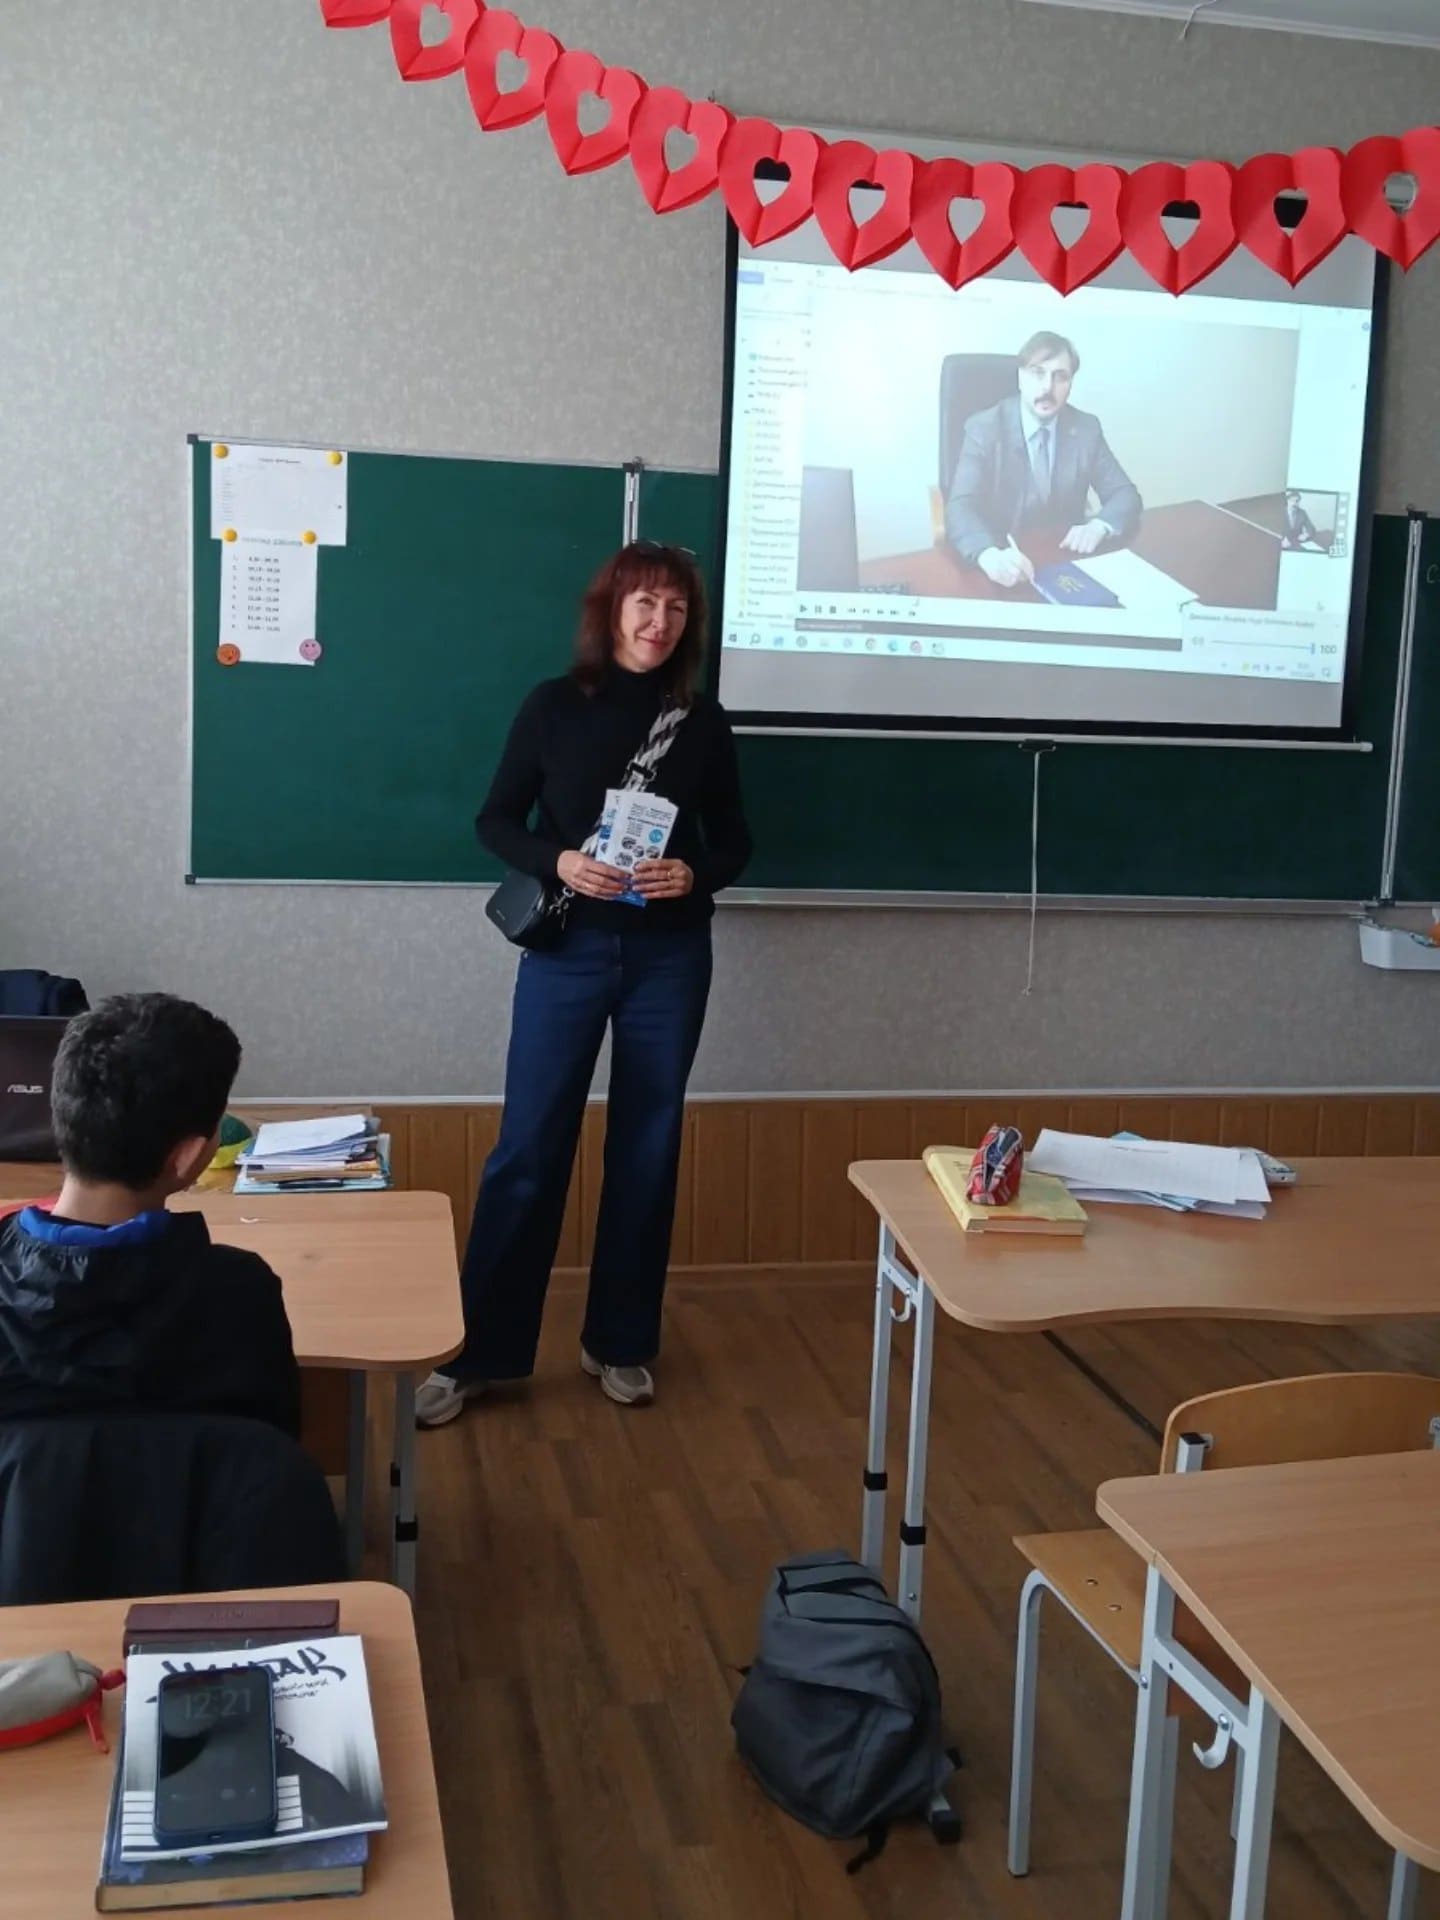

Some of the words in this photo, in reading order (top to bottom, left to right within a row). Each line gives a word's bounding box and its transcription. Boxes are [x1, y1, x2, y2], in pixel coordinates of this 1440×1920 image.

[1320, 644, 1337, 655] 100
[7, 1084, 43, 1094] ASUS
[183, 1687, 251, 1721] 12:21
